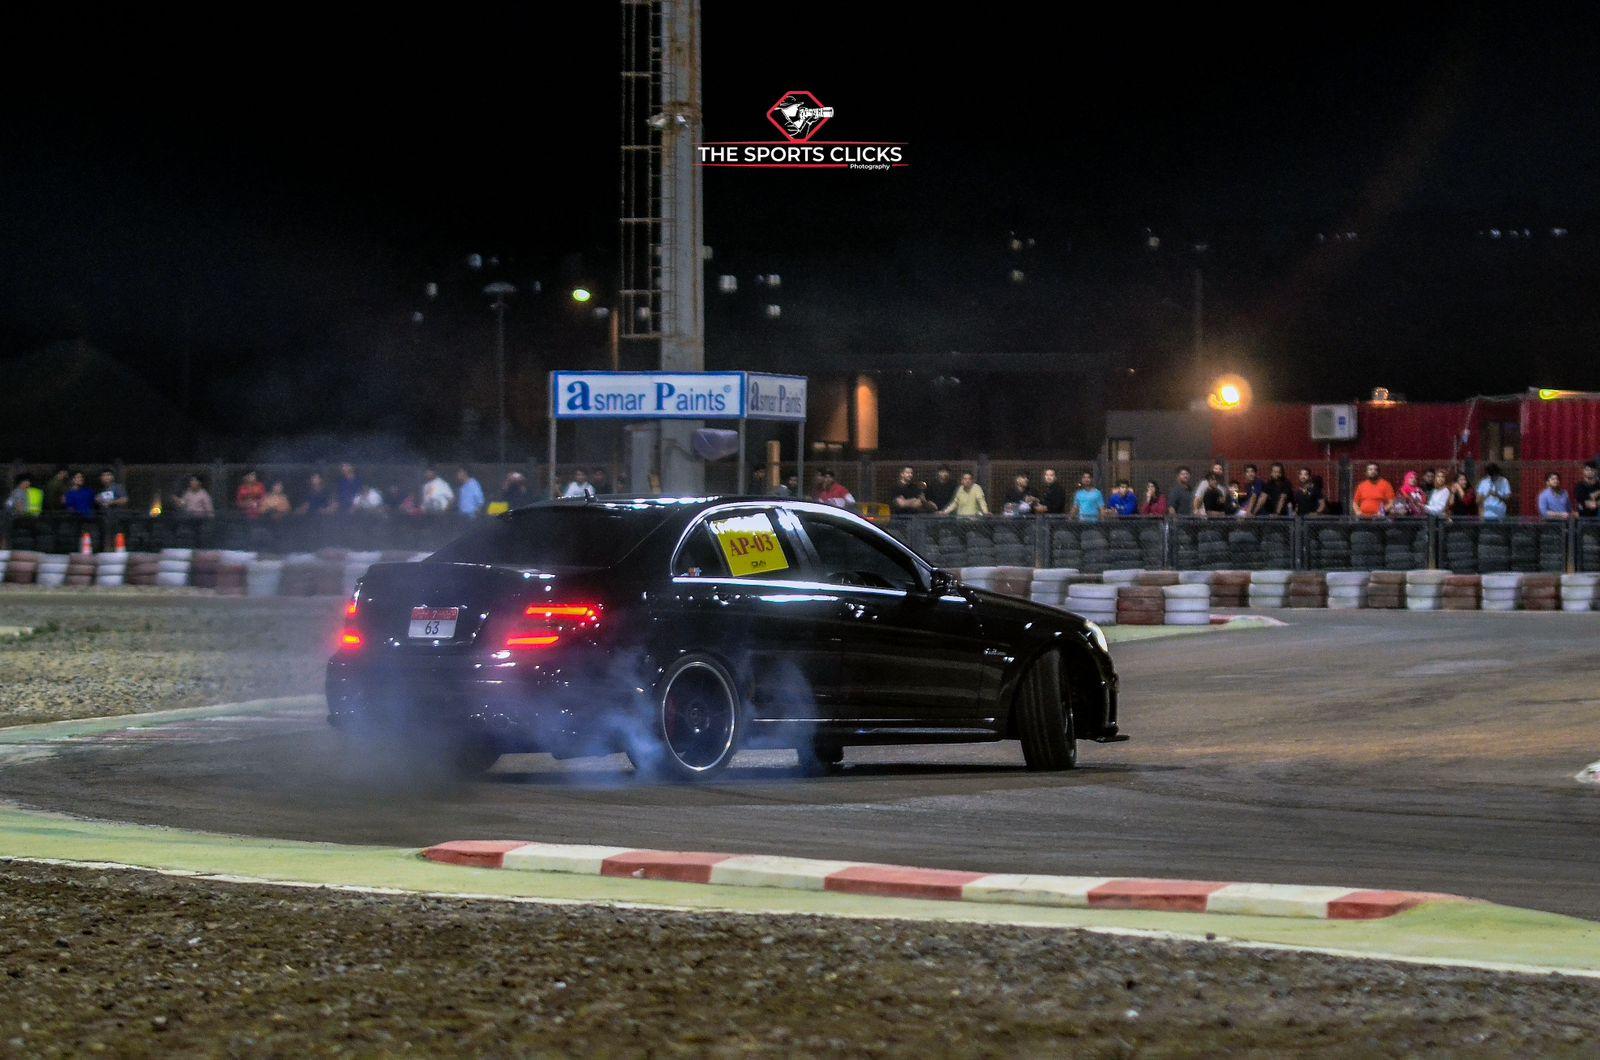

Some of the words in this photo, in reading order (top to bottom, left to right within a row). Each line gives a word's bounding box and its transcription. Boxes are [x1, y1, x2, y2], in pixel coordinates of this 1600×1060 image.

[566, 380, 646, 411] asmar
[730, 534, 774, 557] AP-03
[425, 621, 440, 635] 63
